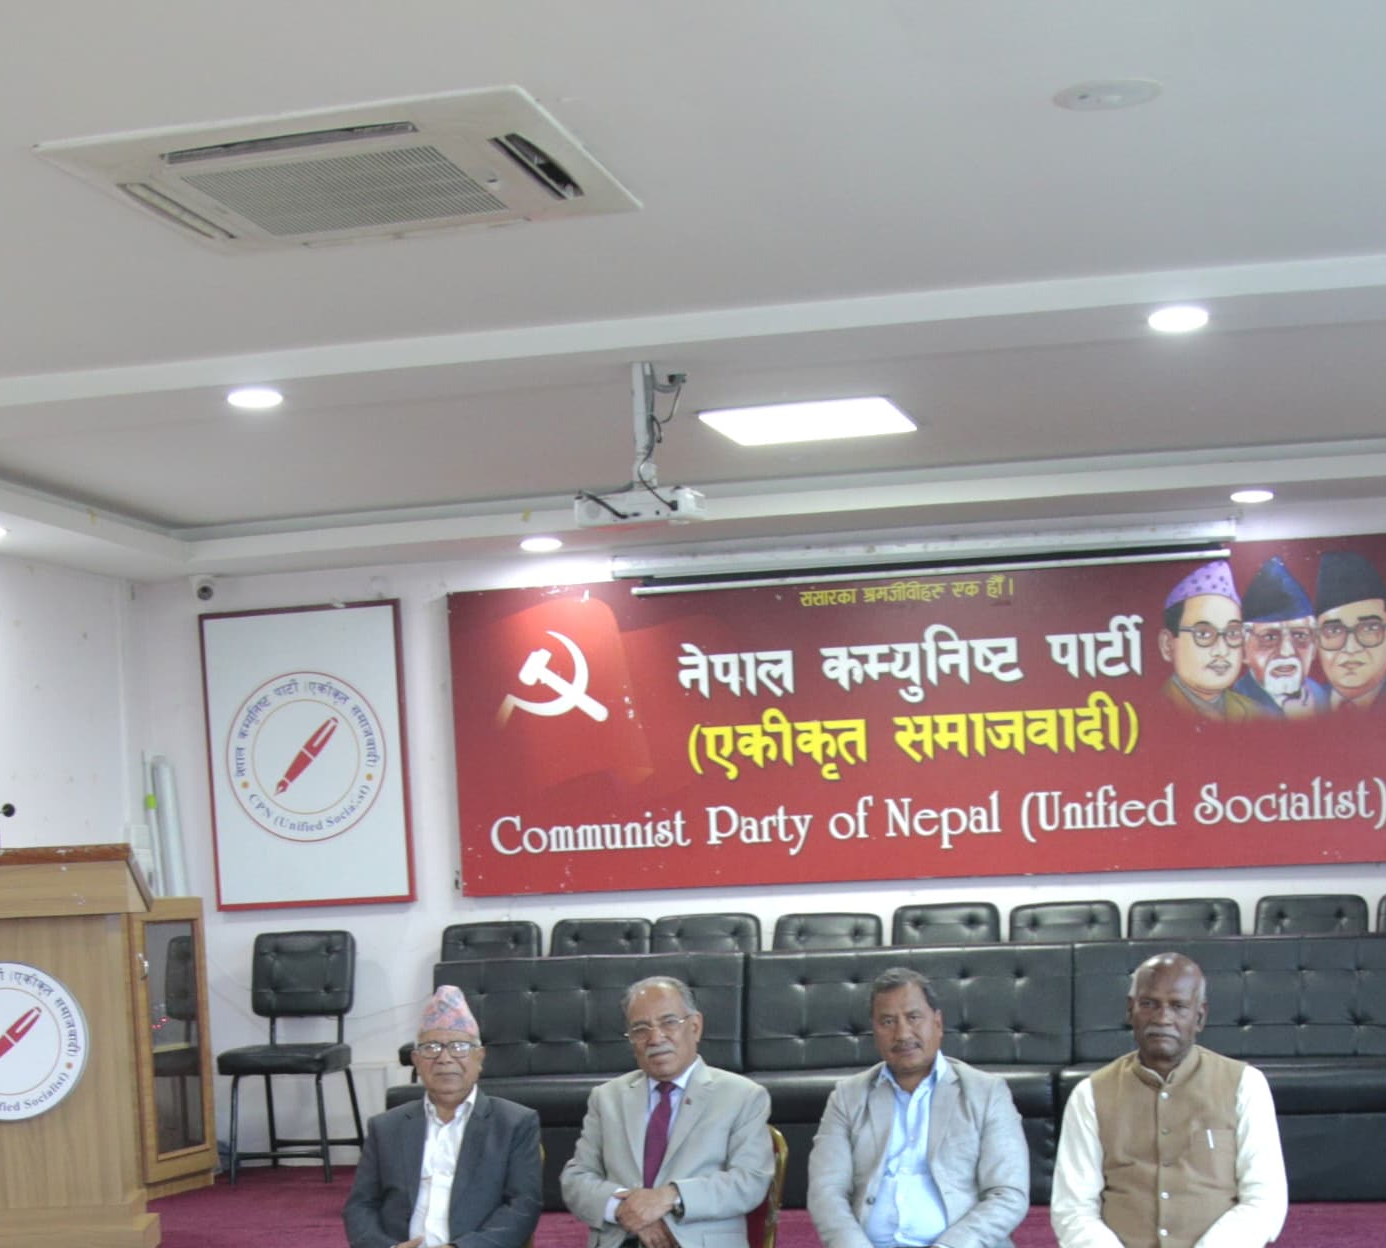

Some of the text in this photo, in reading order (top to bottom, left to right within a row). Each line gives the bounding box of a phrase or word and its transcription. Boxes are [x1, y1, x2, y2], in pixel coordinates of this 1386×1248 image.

[951, 580, 982, 598] एक
[677, 614, 1145, 703] नेपाल कम्युनिष्ट पार्टी
[687, 690, 1140, 781] (एकीकृत समाजवादी)
[490, 808, 692, 855] Communist
[705, 804, 814, 856] Party
[828, 795, 874, 841] of
[884, 789, 1002, 850] Nepal
[1020, 782, 1178, 843] (Unified
[24, 1071, 71, 1110] Socialist)
